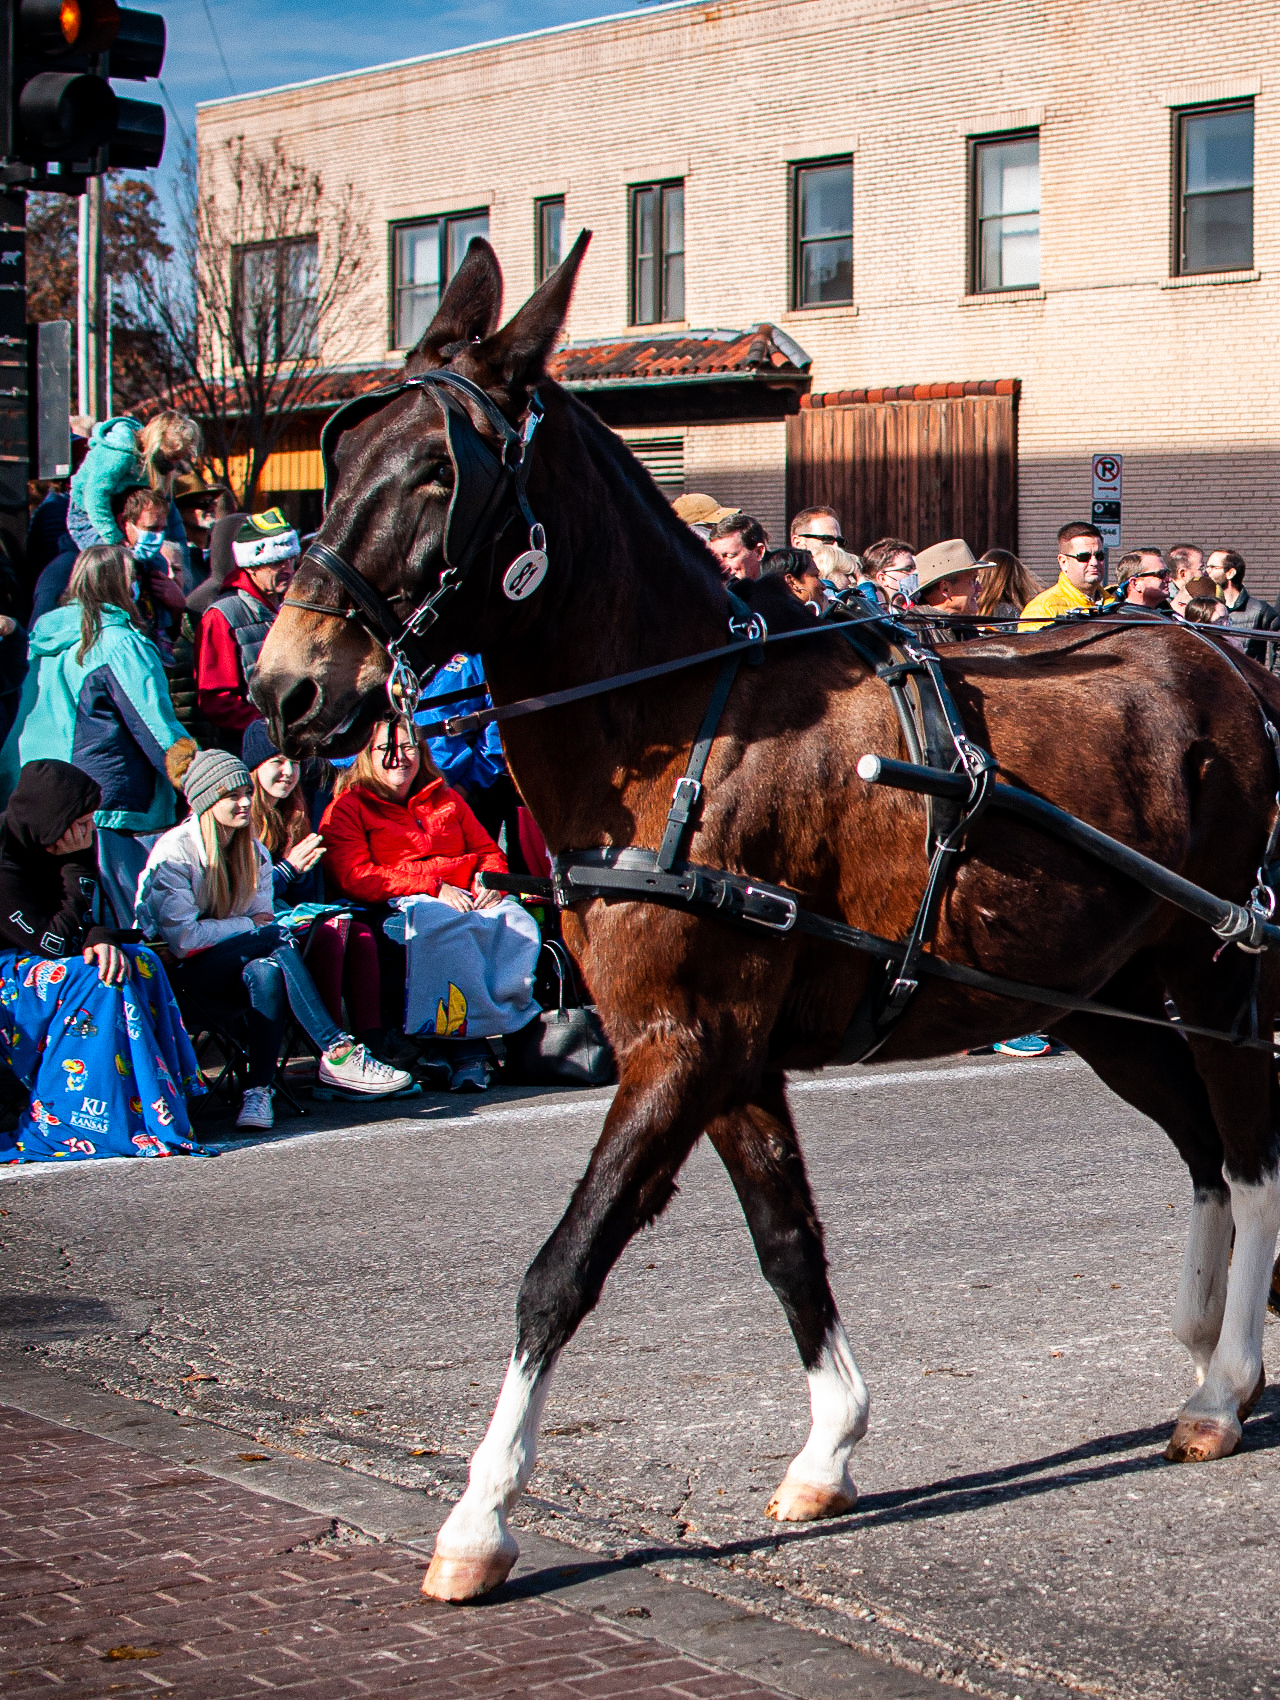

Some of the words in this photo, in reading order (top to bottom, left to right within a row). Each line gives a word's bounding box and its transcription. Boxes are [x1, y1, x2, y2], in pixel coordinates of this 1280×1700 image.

[80, 1096, 108, 1117] KU
[150, 1096, 175, 1127] KU
[70, 1114, 110, 1134] KANSAS
